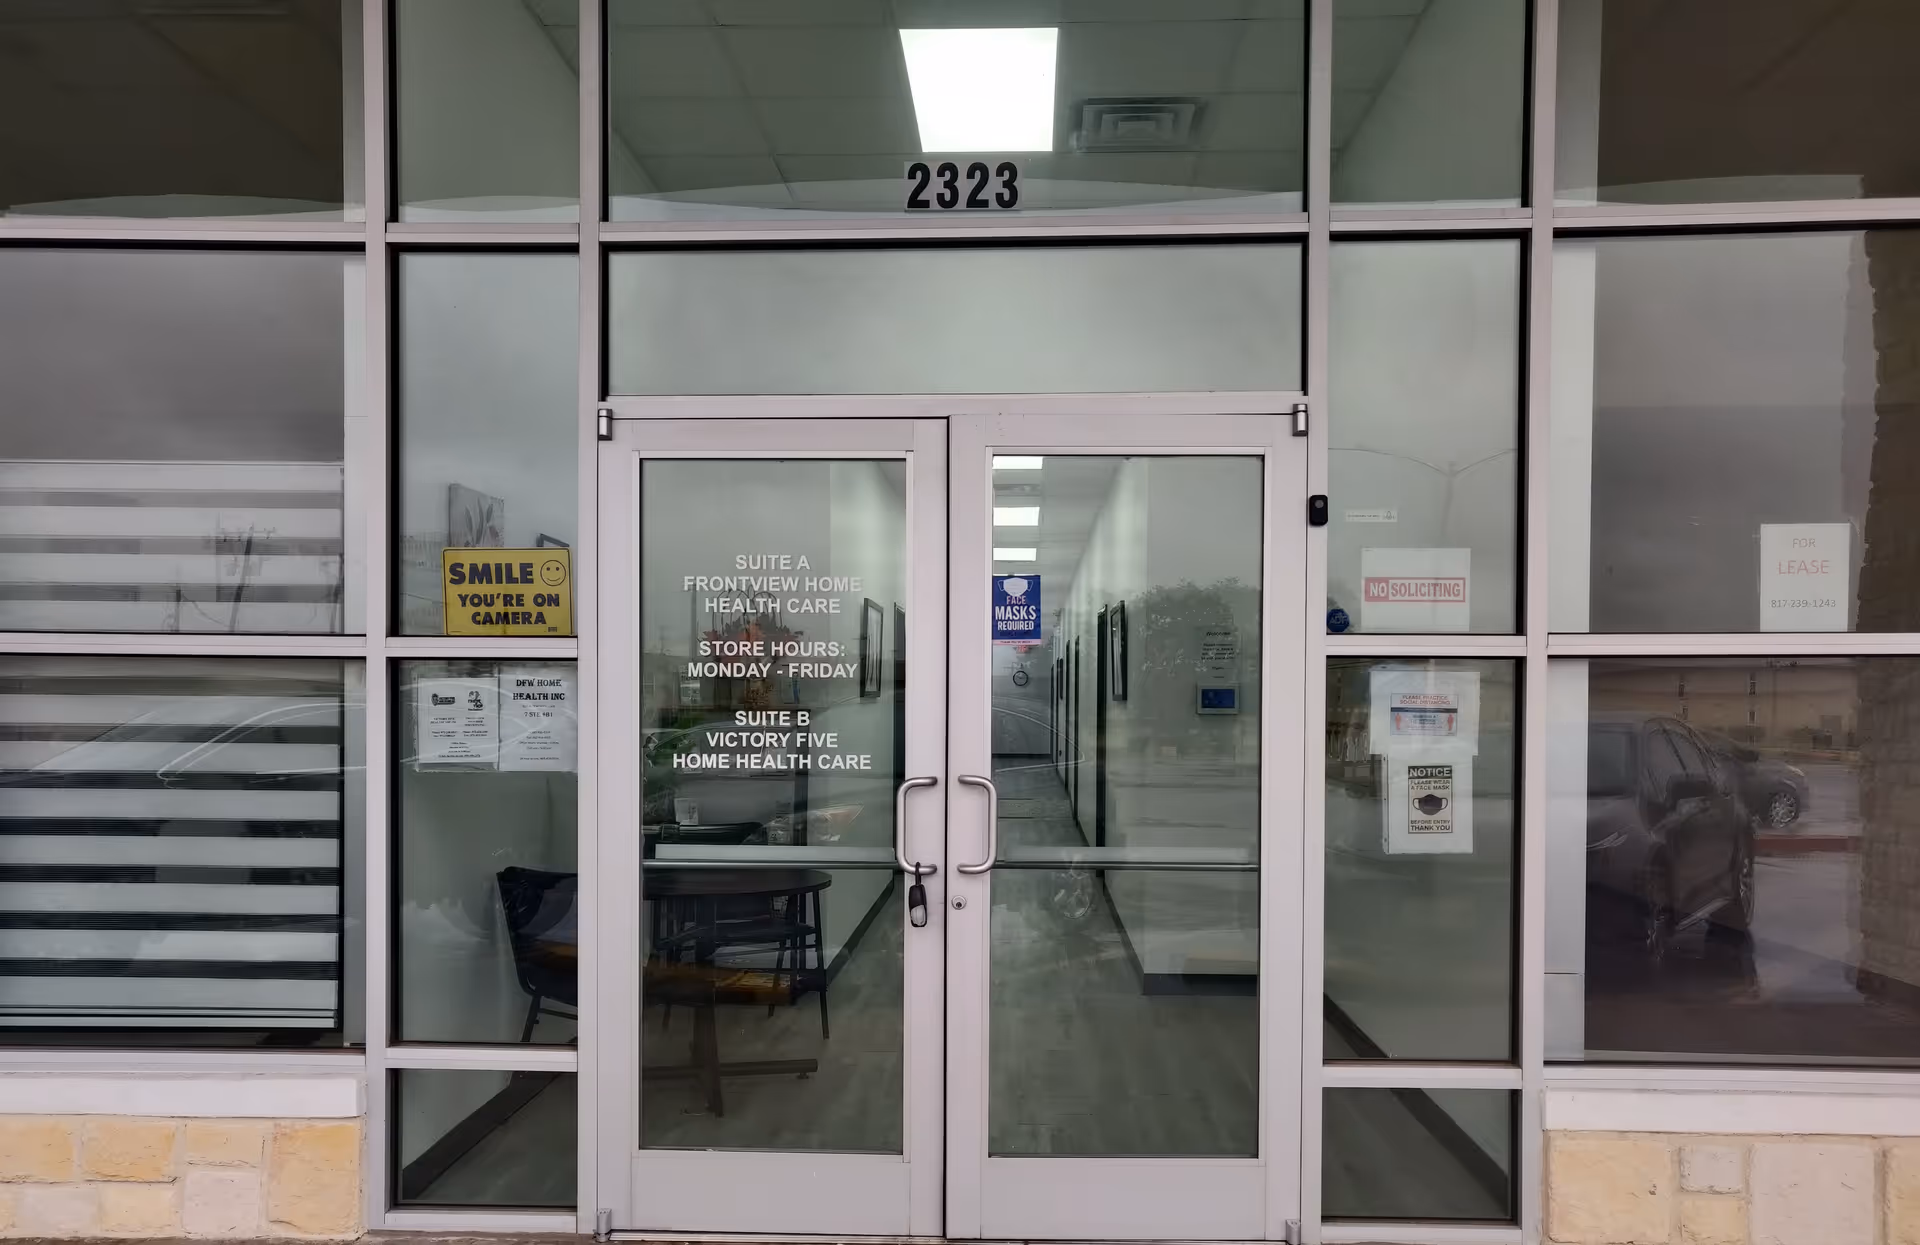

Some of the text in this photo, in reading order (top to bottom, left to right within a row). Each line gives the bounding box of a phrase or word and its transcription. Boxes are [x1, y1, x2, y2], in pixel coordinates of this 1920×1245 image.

[907, 162, 1018, 209] 2323
[1792, 538, 1816, 548] FOR
[735, 555, 810, 570] SUITE A
[1778, 560, 1830, 575] LEASE
[449, 562, 534, 585] SMILE
[684, 576, 863, 592] FRONTVIEW HOME
[1370, 582, 1461, 597] NO SOLICITING
[457, 593, 560, 607] YOU'RE ON
[705, 598, 841, 614] HEALTH CARE
[1006, 595, 1027, 605] FACE
[471, 611, 547, 625] CAMERA
[995, 605, 1037, 621] MASKS
[997, 620, 1035, 631] REQUIRED
[699, 641, 846, 657] STORE HOURS:
[687, 662, 771, 678] MONDAY
[788, 663, 858, 678] FRIDAY
[516, 679, 562, 687] DFW HOME
[512, 693, 565, 701] HEALTH INC
[735, 711, 810, 726] SUITE B
[706, 732, 838, 748] VICTORY FIVE
[673, 753, 872, 770] HOME HEALTH CARE
[1409, 767, 1451, 777] NOTICE
